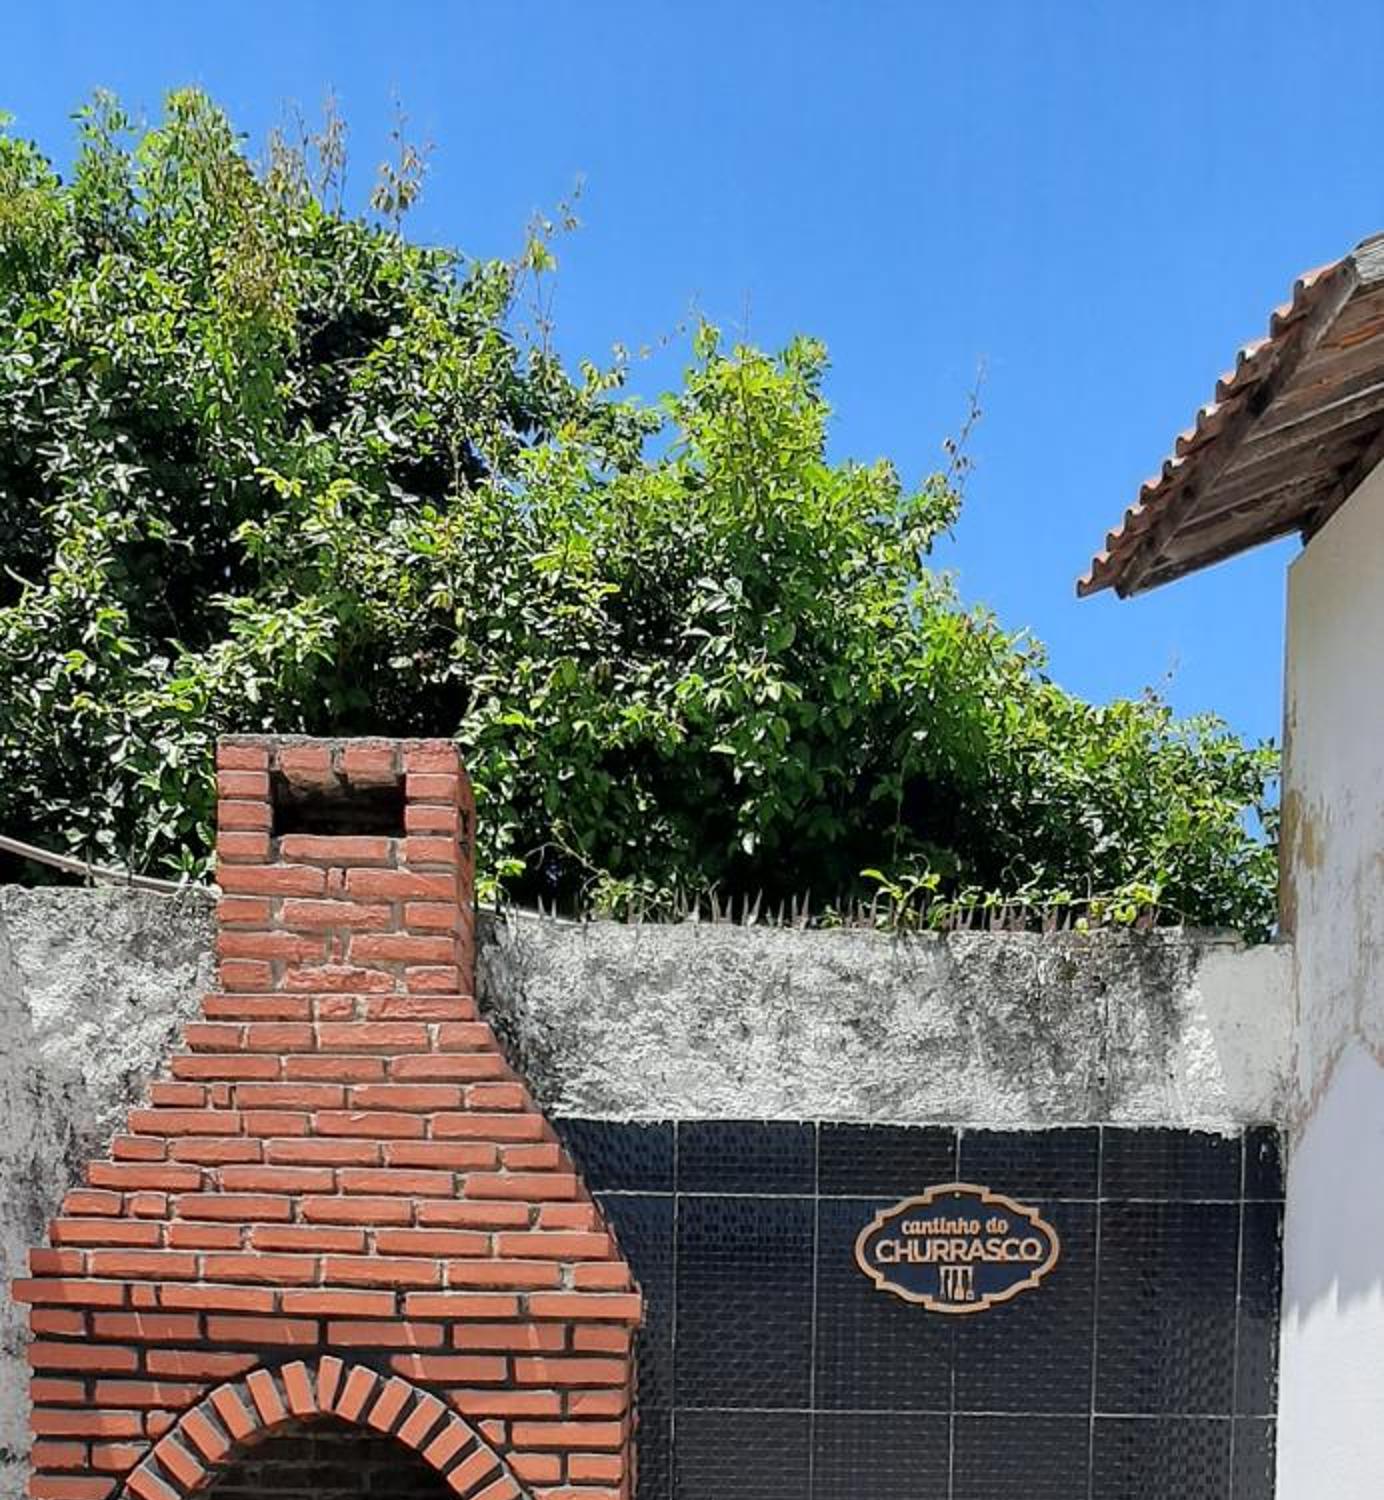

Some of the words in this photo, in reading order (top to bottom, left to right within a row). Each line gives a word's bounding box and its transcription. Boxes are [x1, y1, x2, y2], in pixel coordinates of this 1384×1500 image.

[902, 1217, 980, 1235] cantinho
[986, 1217, 1009, 1234] do
[875, 1238, 1042, 1262] CHURRASCO
